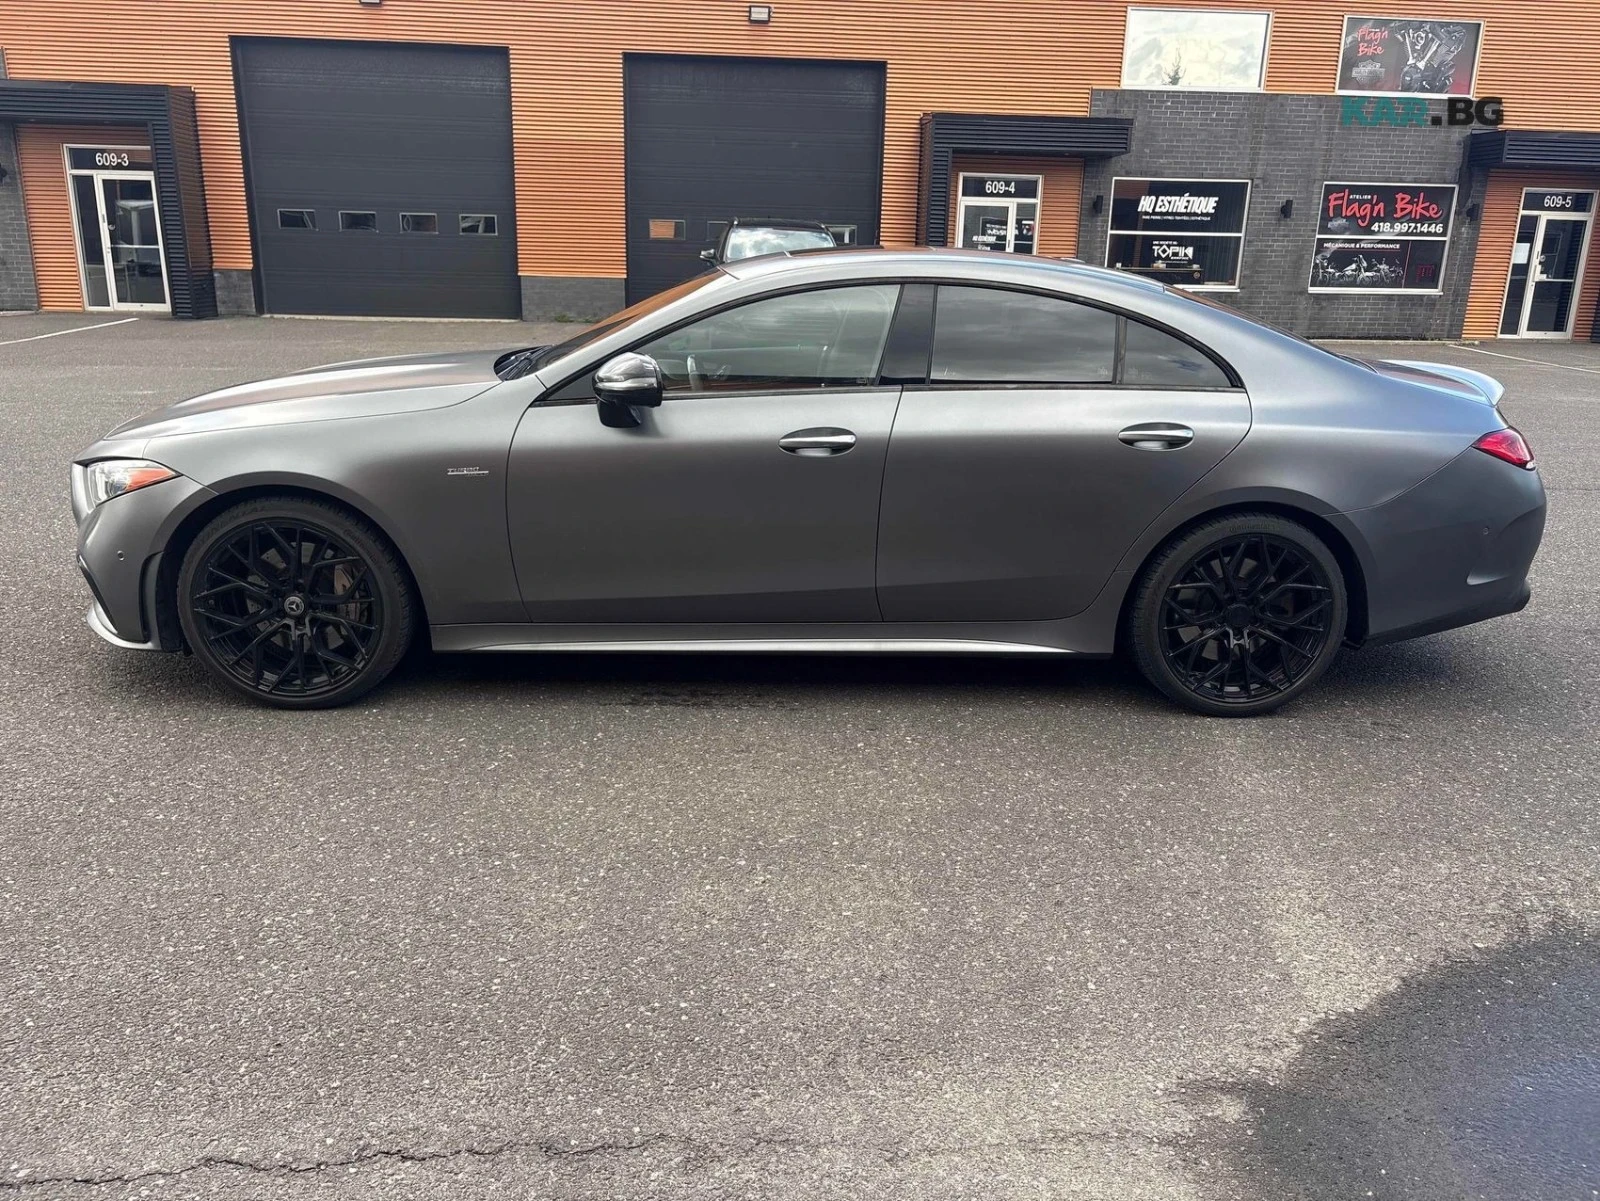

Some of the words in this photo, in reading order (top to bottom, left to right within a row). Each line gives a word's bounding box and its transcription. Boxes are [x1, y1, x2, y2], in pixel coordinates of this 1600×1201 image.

[1357, 26, 1388, 44] Flag'n
[1357, 42, 1385, 56] Bike
[95, 152, 129, 166] 609-3
[985, 181, 1015, 194] 609-4
[1137, 195, 1157, 213] HQ
[1154, 192, 1219, 214] ESTHÉTIQUE
[1328, 188, 1385, 227] Flag'n
[1393, 192, 1443, 220] Bike
[1543, 195, 1572, 208] 609-5
[1371, 222, 1444, 234] 418.997.1446
[1323, 241, 1355, 249] MÉCANIQUE
[1360, 242, 1400, 250] PERFORMANCE
